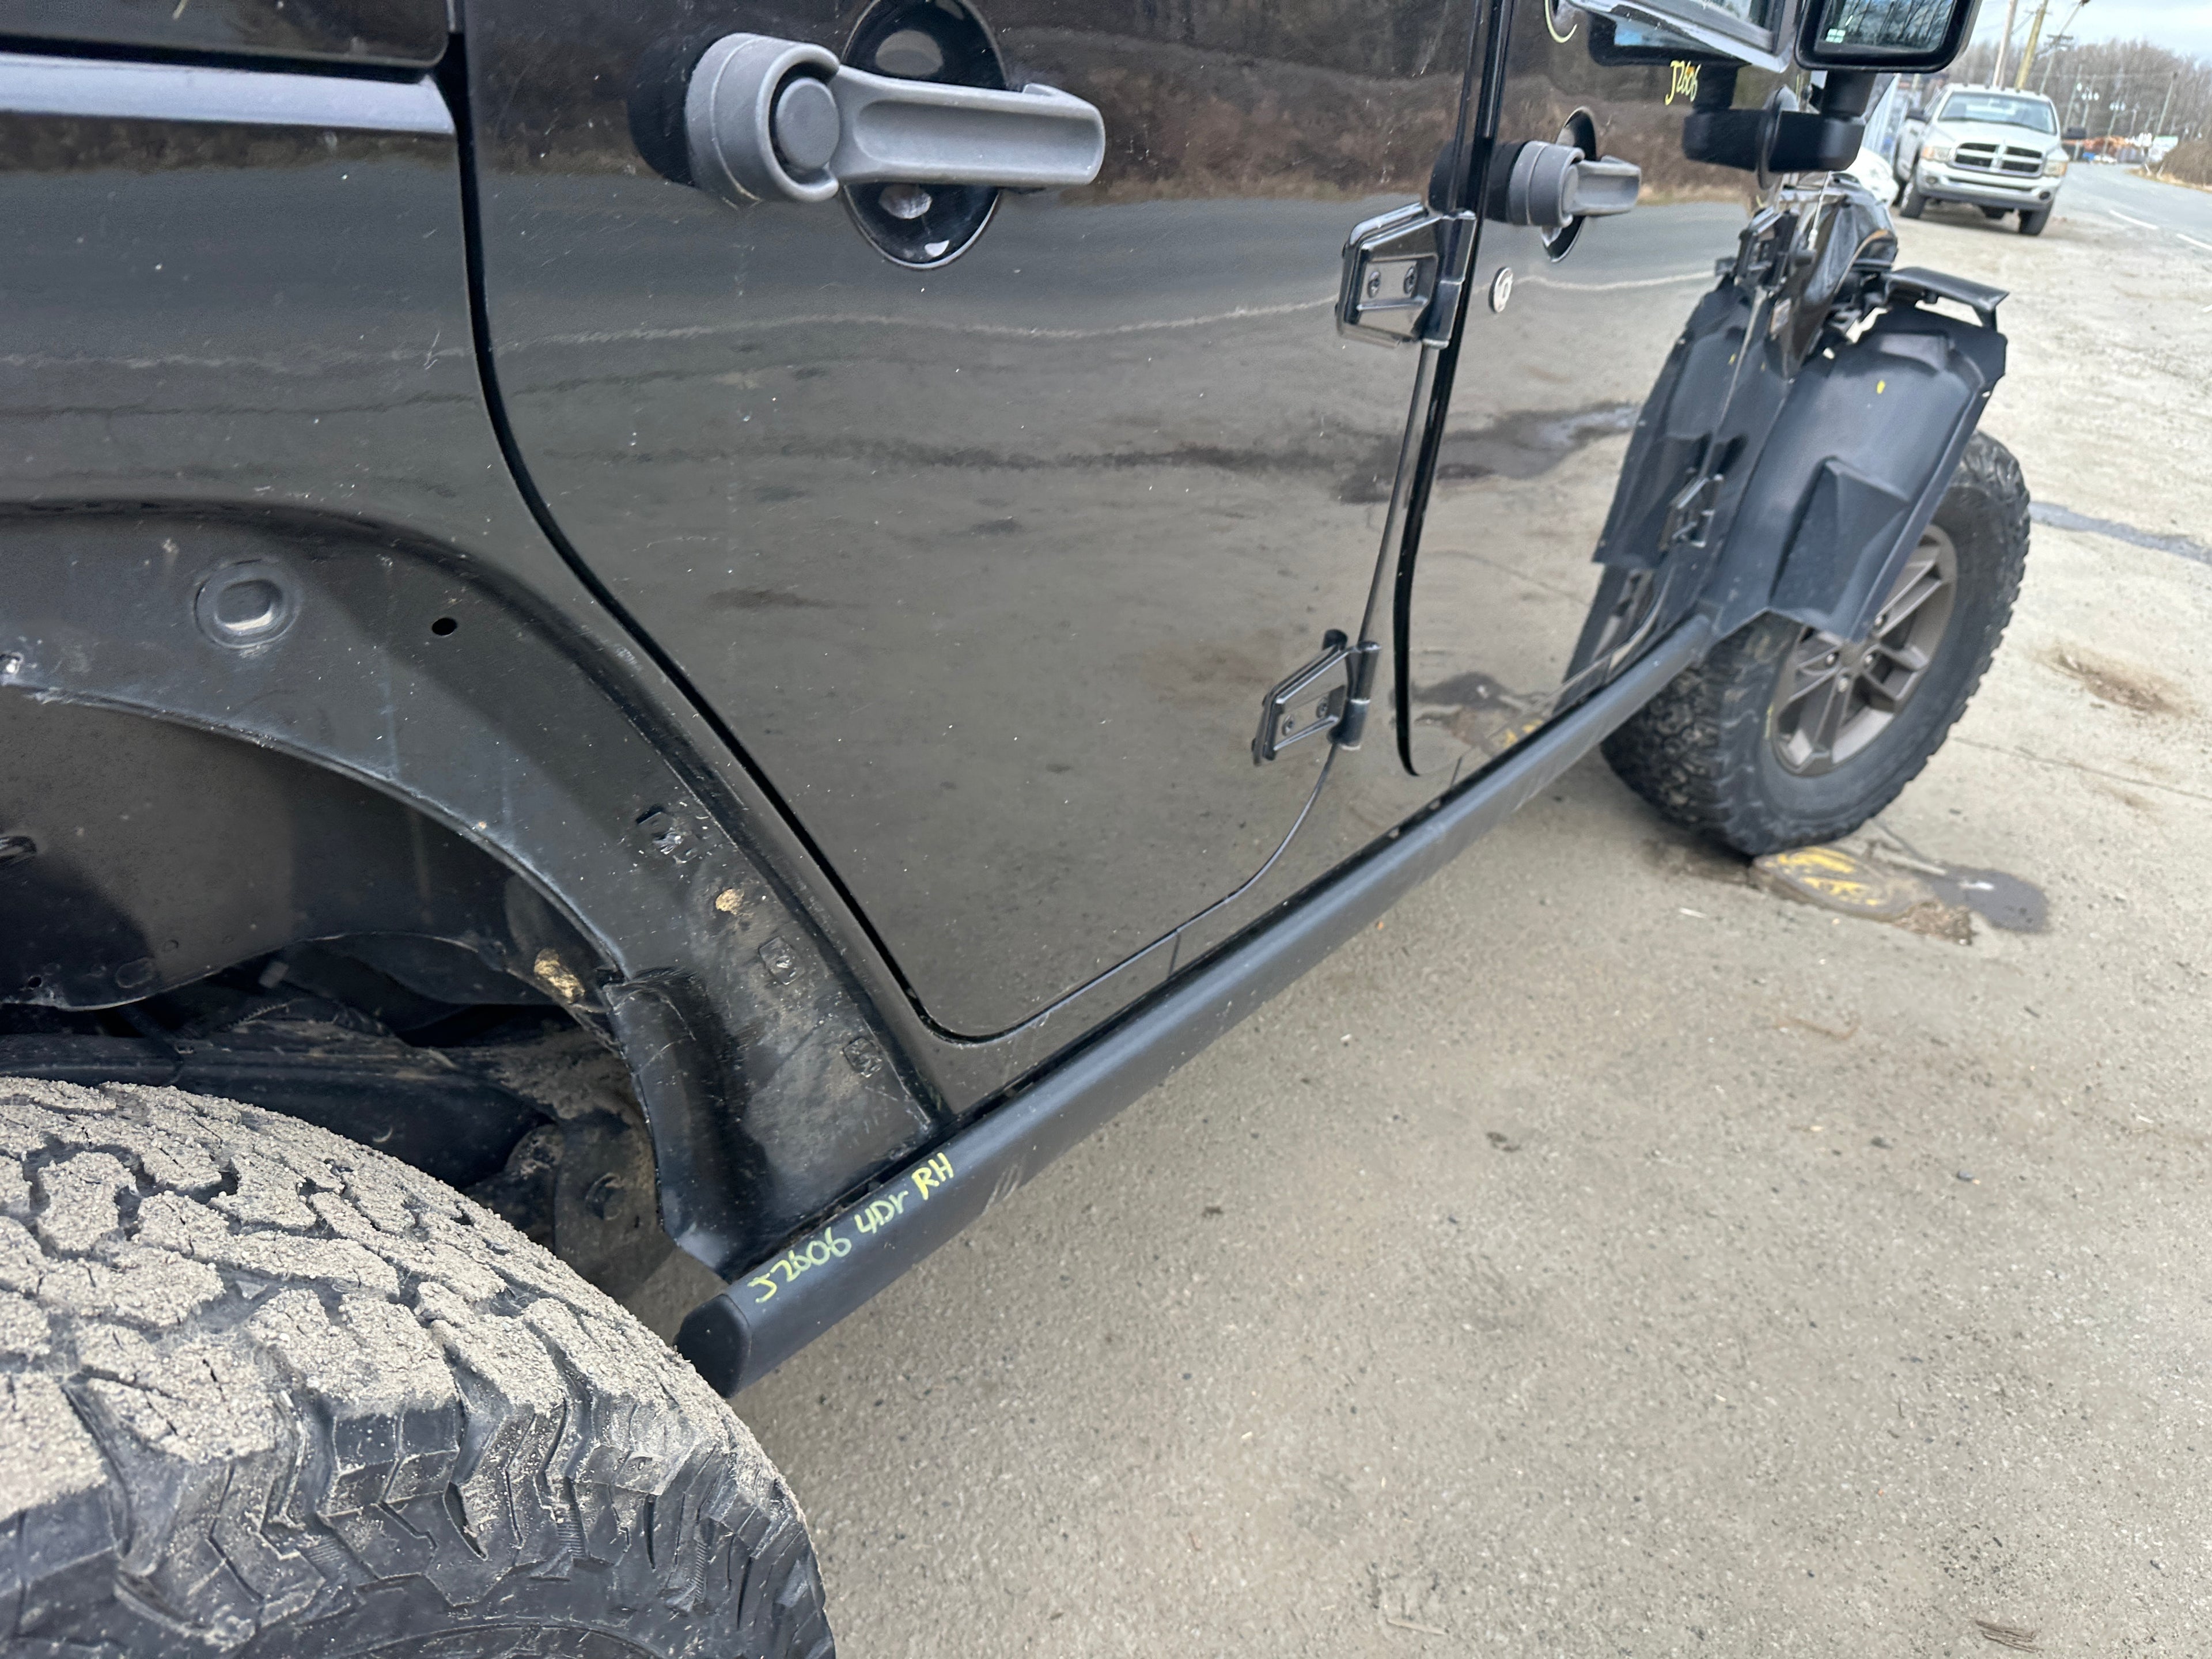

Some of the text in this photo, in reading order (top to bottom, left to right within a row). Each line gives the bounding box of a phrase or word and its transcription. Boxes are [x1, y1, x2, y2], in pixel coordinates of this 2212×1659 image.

[748, 1152, 954, 1303] J2606 4Dr RH
